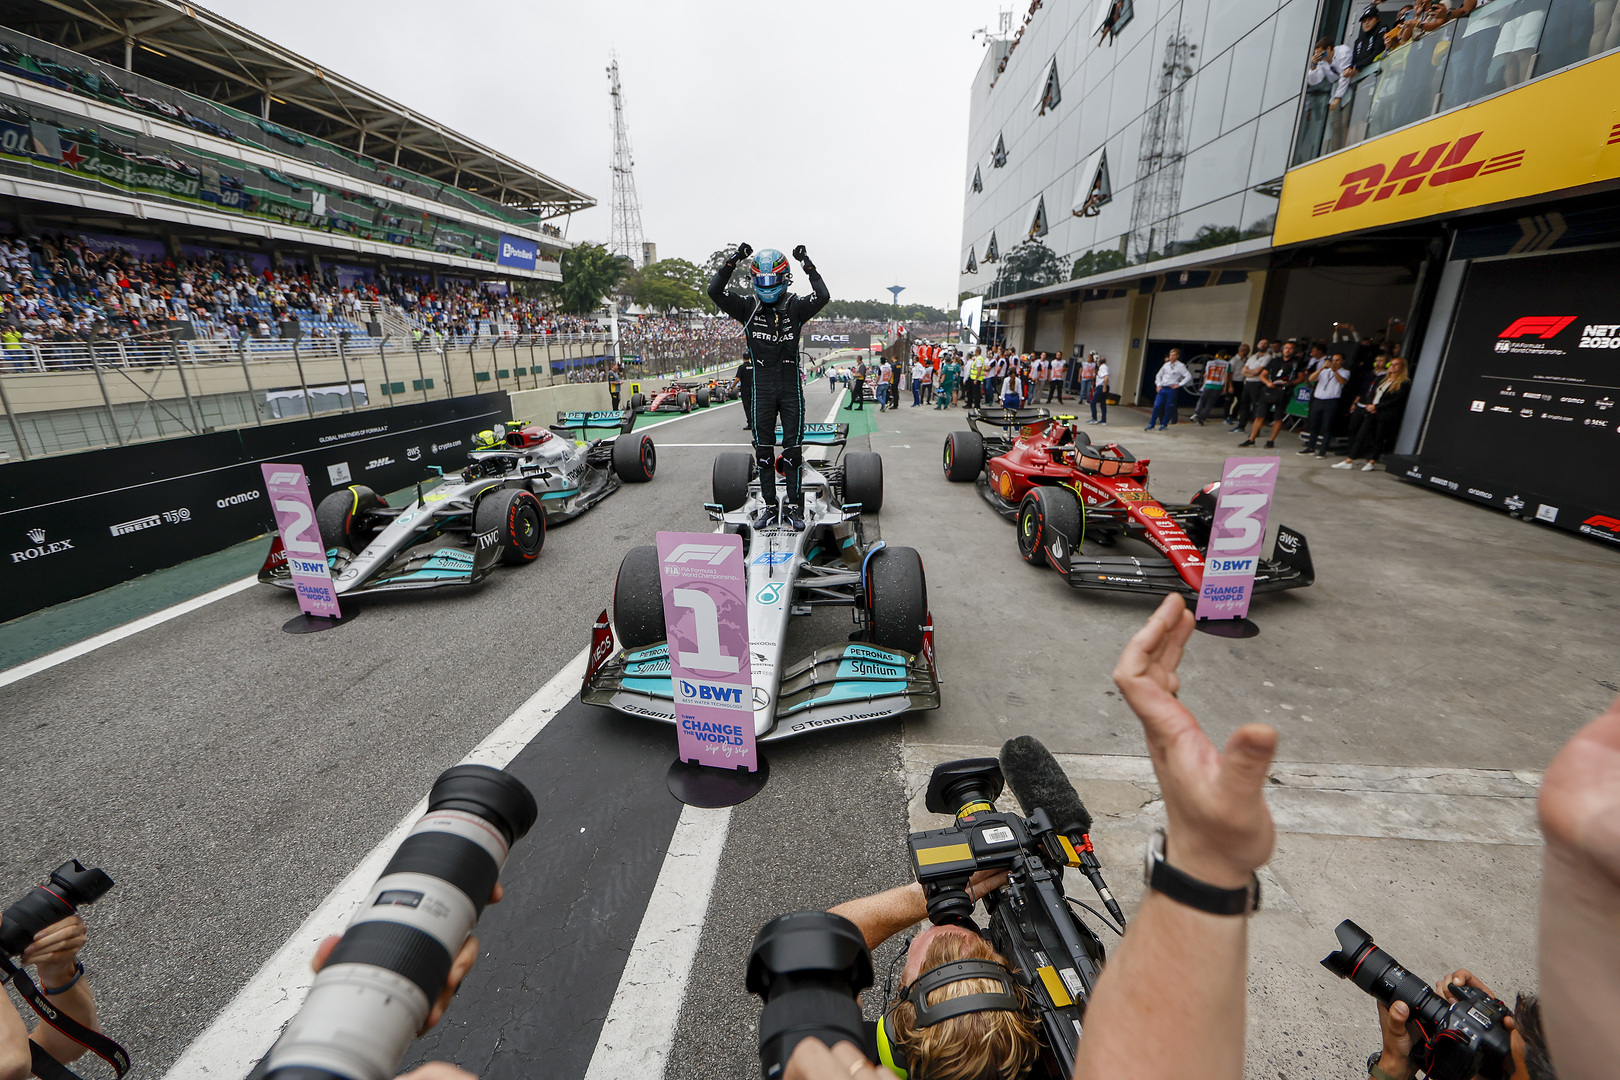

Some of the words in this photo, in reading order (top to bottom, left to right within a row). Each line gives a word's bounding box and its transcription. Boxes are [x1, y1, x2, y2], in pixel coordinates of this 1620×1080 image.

[1328, 131, 1490, 213] DHL
[510, 246, 534, 261] PortoBank
[1497, 316, 1578, 339] F1
[1495, 342, 1510, 351] FIA
[1578, 337, 1620, 349] 2030
[1560, 396, 1585, 404] aramco
[319, 435, 338, 443] GLOBAL
[338, 431, 360, 439] PARTNERS
[406, 446, 420, 456] aws
[438, 440, 462, 451] crypto.com
[367, 456, 393, 469] DHL
[1225, 463, 1276, 478] F1
[268, 472, 302, 486] F1
[216, 490, 261, 509] aramco
[1098, 490, 1109, 499] MILLE
[1468, 488, 1493, 499] aramco
[109, 514, 162, 537] PIRELLI
[274, 499, 321, 554] 2
[1213, 494, 1269, 551] 3
[479, 529, 500, 549] IWC
[1279, 531, 1300, 548] aws
[10, 538, 75, 564] ROLEX
[271, 550, 287, 563] INE
[663, 544, 737, 565] F1
[301, 562, 324, 574] BWT
[664, 566, 680, 576] FIA
[1222, 559, 1252, 570] BWT
[298, 586, 330, 595] CHANGE
[307, 594, 331, 602] WORLD
[1204, 586, 1245, 595] CHANGE
[1211, 594, 1243, 602] WORLD
[673, 588, 739, 674] 1
[850, 648, 894, 661] PETRONAS
[851, 661, 897, 676] Syntium
[699, 685, 743, 703] BWT
[805, 709, 892, 728] TeamViewer
[682, 720, 743, 736] CHANGE
[695, 731, 743, 746] WORLD
[706, 743, 719, 755] sip
[722, 740, 733, 758] by
[735, 746, 749, 757] sip
[35, 996, 57, 1020] Canon
